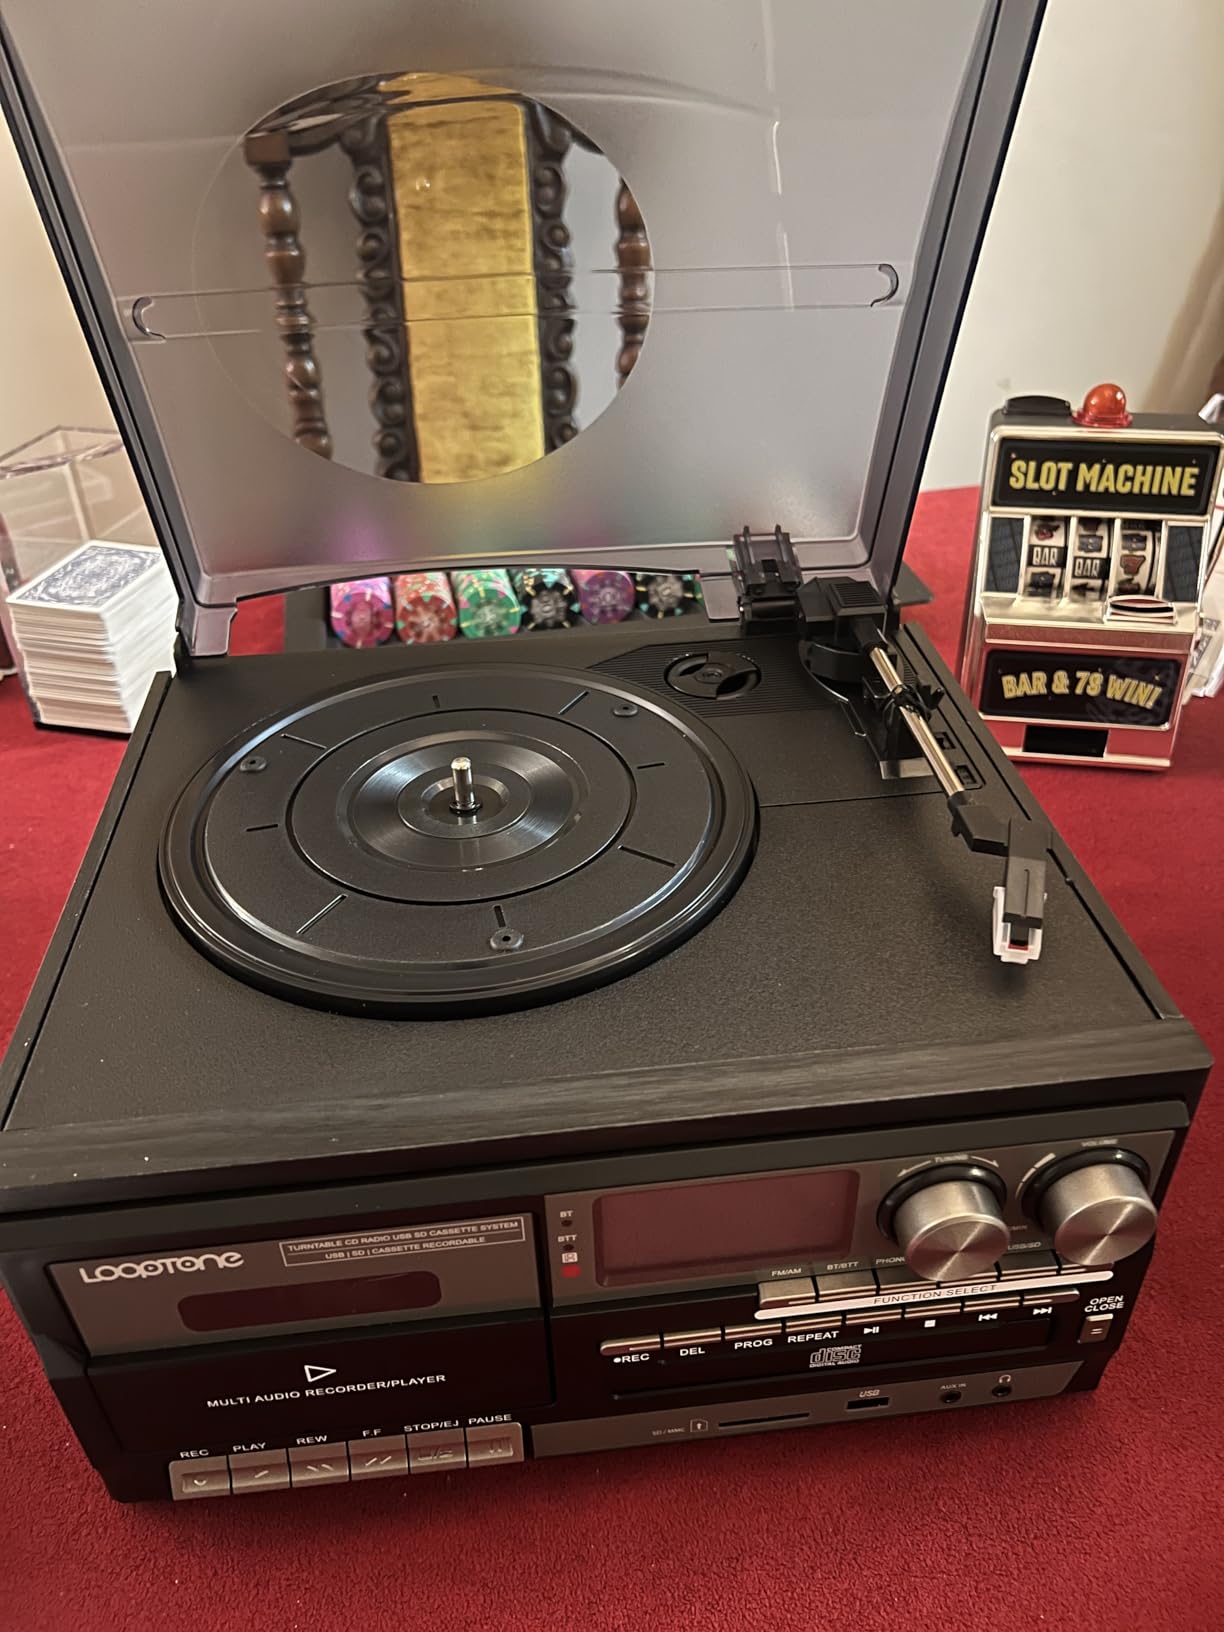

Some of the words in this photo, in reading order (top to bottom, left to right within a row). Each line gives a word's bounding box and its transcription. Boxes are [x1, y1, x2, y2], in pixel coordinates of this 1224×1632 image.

[1009, 459, 1073, 491] SLOT
[1077, 463, 1199, 496] MACHINE
[1032, 547, 1059, 566] BAR
[1074, 557, 1100, 577] BAR
[1002, 671, 1046, 699] BAR
[1052, 670, 1069, 695] &
[1106, 674, 1163, 710] WIN!
[560, 1210, 574, 1218] BT
[287, 1240, 343, 1252] TURNTABLE
[344, 1238, 358, 1246] CD
[361, 1235, 390, 1245] RADIO
[392, 1232, 412, 1241] USB
[414, 1231, 428, 1239] SD
[429, 1225, 478, 1237] CASSETTE
[480, 1221, 519, 1232] SYSTEM
[557, 1234, 577, 1242] BTT
[325, 1251, 344, 1259] USB
[352, 1249, 365, 1257] SD
[372, 1243, 420, 1256] CASSETTE
[422, 1236, 486, 1249] RECORDABLE
[827, 1261, 860, 1271] BT/BTT
[875, 1256, 906, 1265] PHON
[771, 1268, 802, 1277] FM/AM
[873, 1290, 942, 1305] FUNCTION
[946, 1284, 998, 1297] SELECT
[1089, 1295, 1124, 1306] OPEN
[1084, 1301, 1125, 1313] CLOSE
[787, 1330, 839, 1343] REPEAT
[734, 1338, 774, 1350] PROG
[679, 1347, 706, 1356] DEL
[207, 1396, 250, 1408] MULTI
[254, 1391, 300, 1403] AUDIO
[305, 1374, 446, 1397] RECORDER/PLAYER
[859, 1389, 881, 1398] USB
[404, 1419, 459, 1433] STOP/EJ
[468, 1414, 512, 1426] PAUSE
[296, 1435, 328, 1445] REW
[233, 1442, 267, 1453] PLAY
[179, 1449, 209, 1459] REC
